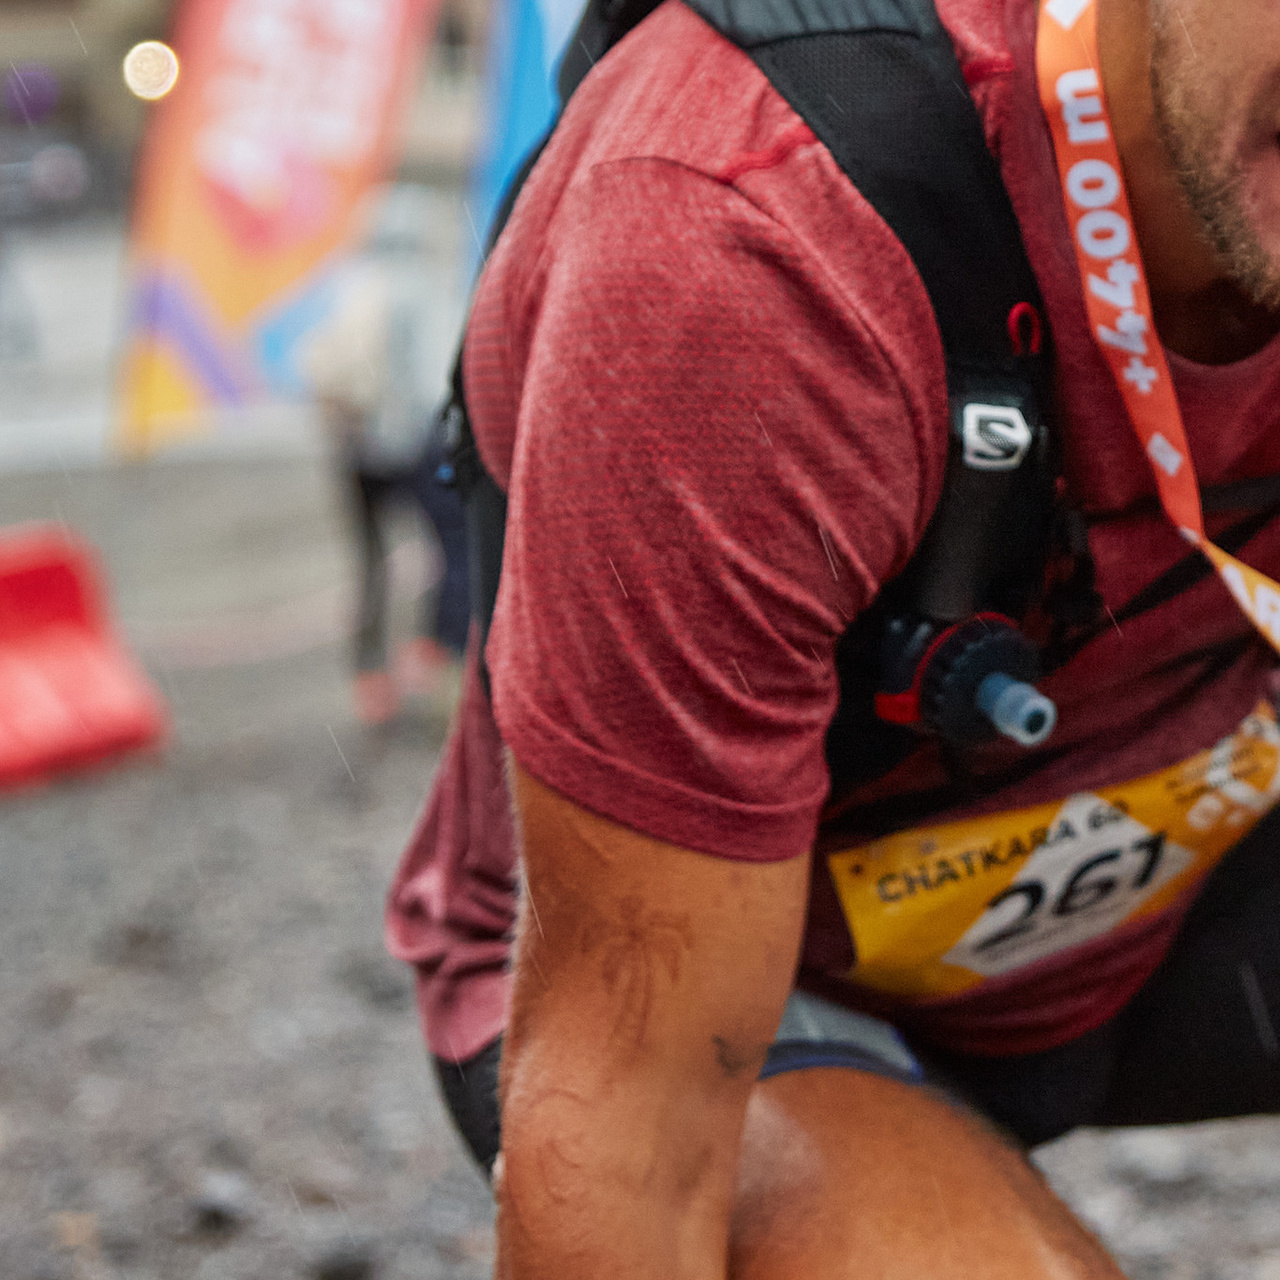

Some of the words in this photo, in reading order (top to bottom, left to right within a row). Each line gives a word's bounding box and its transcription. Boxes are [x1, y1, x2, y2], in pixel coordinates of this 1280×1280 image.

[1054, 68, 1107, 146] m
[1066, 159, 1159, 393] +4400
[875, 818, 1079, 904] CHATKARA
[973, 831, 1168, 956] 261
